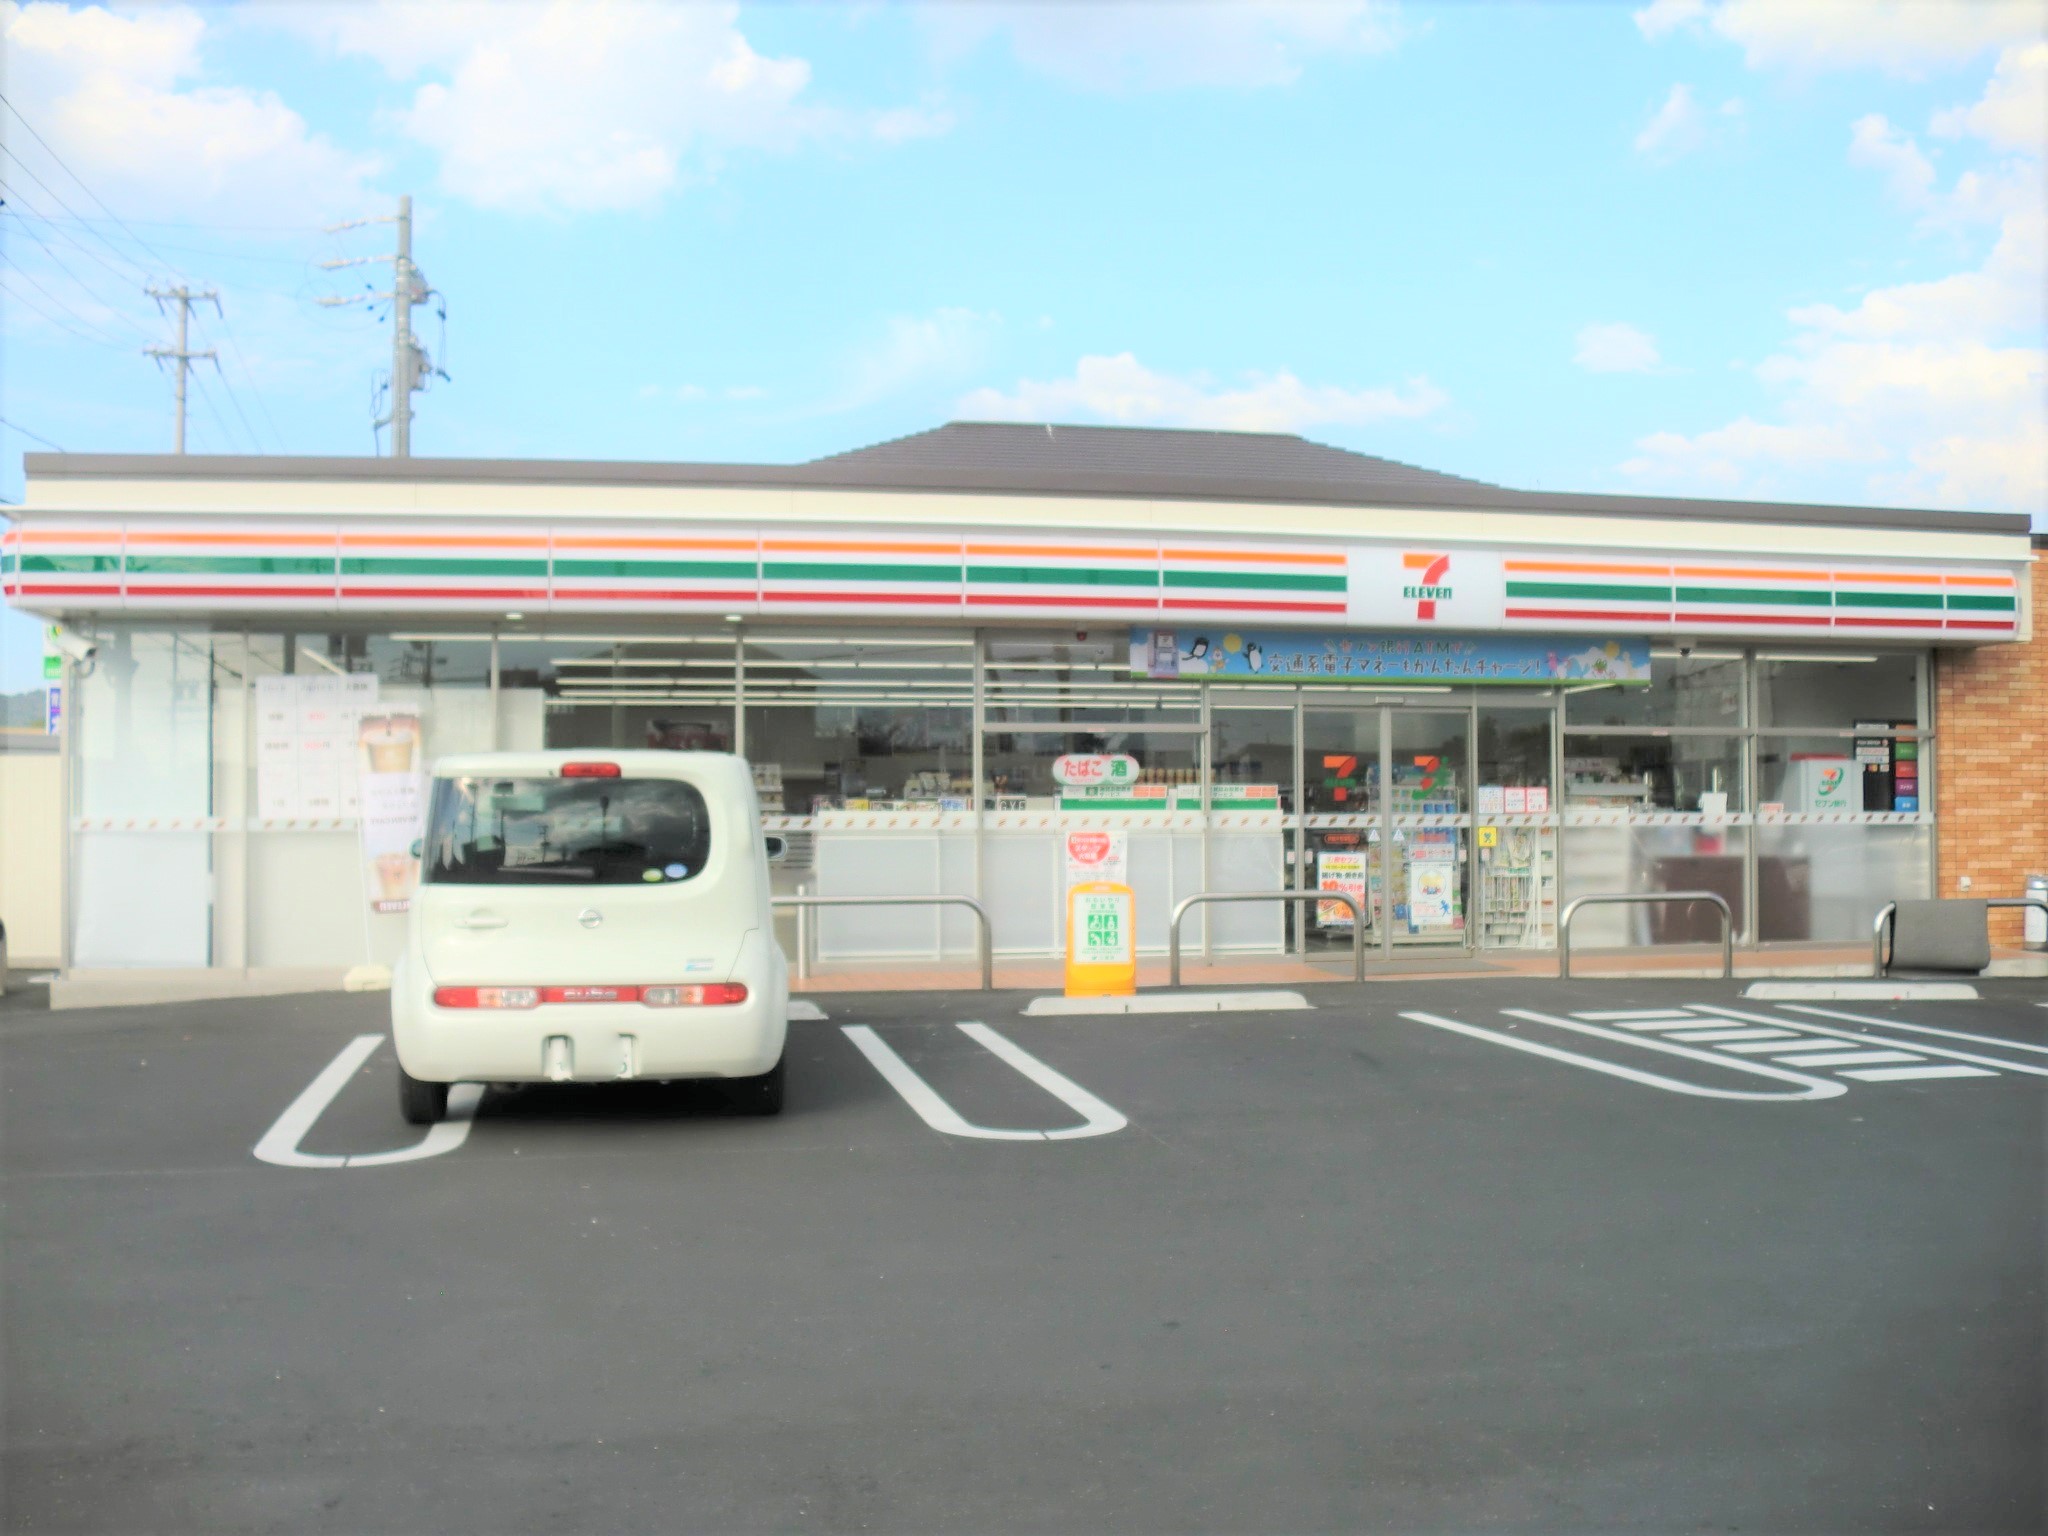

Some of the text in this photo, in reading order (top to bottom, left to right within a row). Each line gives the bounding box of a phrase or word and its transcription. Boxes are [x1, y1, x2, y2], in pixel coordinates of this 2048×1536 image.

[1064, 760, 1127, 777] たばこ 酒
